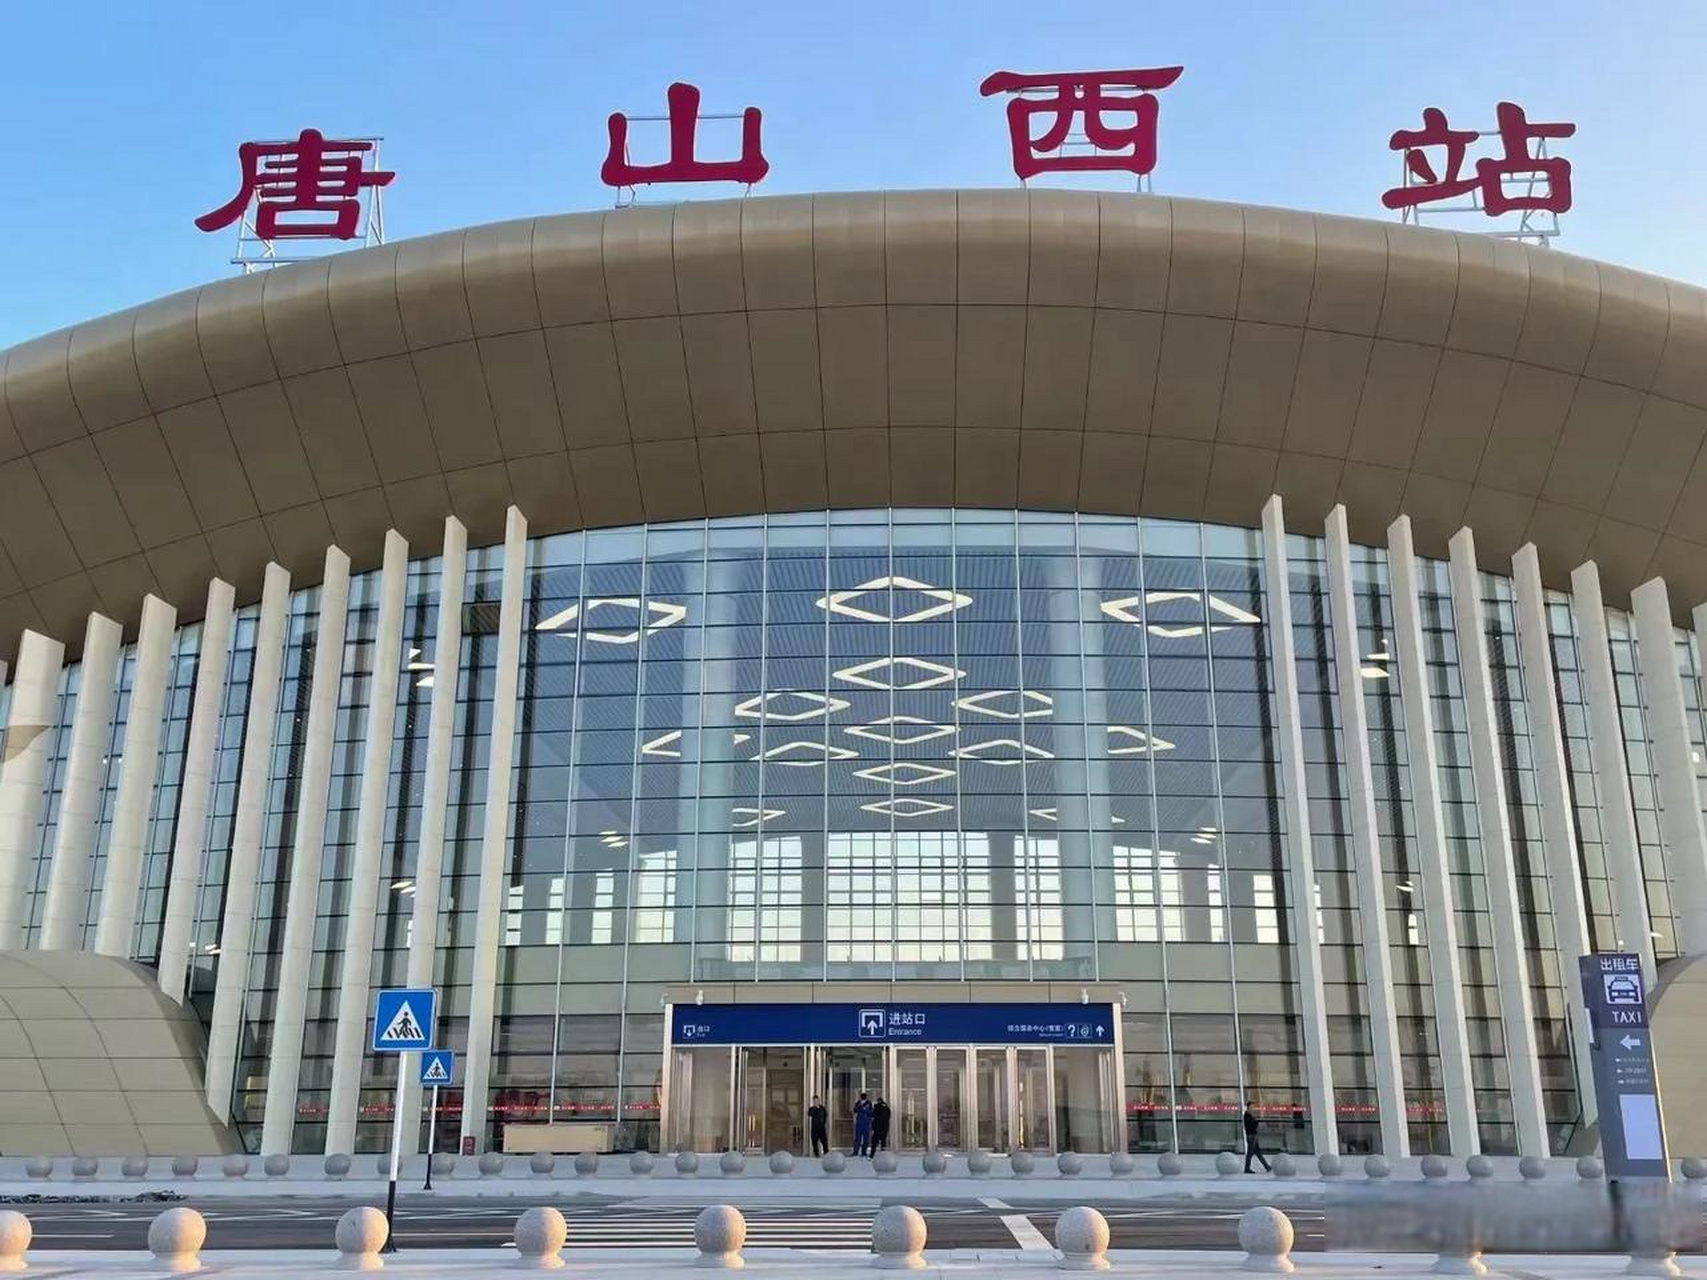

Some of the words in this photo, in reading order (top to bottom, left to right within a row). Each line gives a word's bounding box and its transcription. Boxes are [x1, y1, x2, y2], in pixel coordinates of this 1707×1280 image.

[195, 65, 1577, 241] 唐山西站
[1600, 958, 1638, 971] 出租车
[888, 1012, 926, 1025] 进站口
[1612, 1011, 1642, 1024] TAXI
[888, 1027, 922, 1036] Entrance
